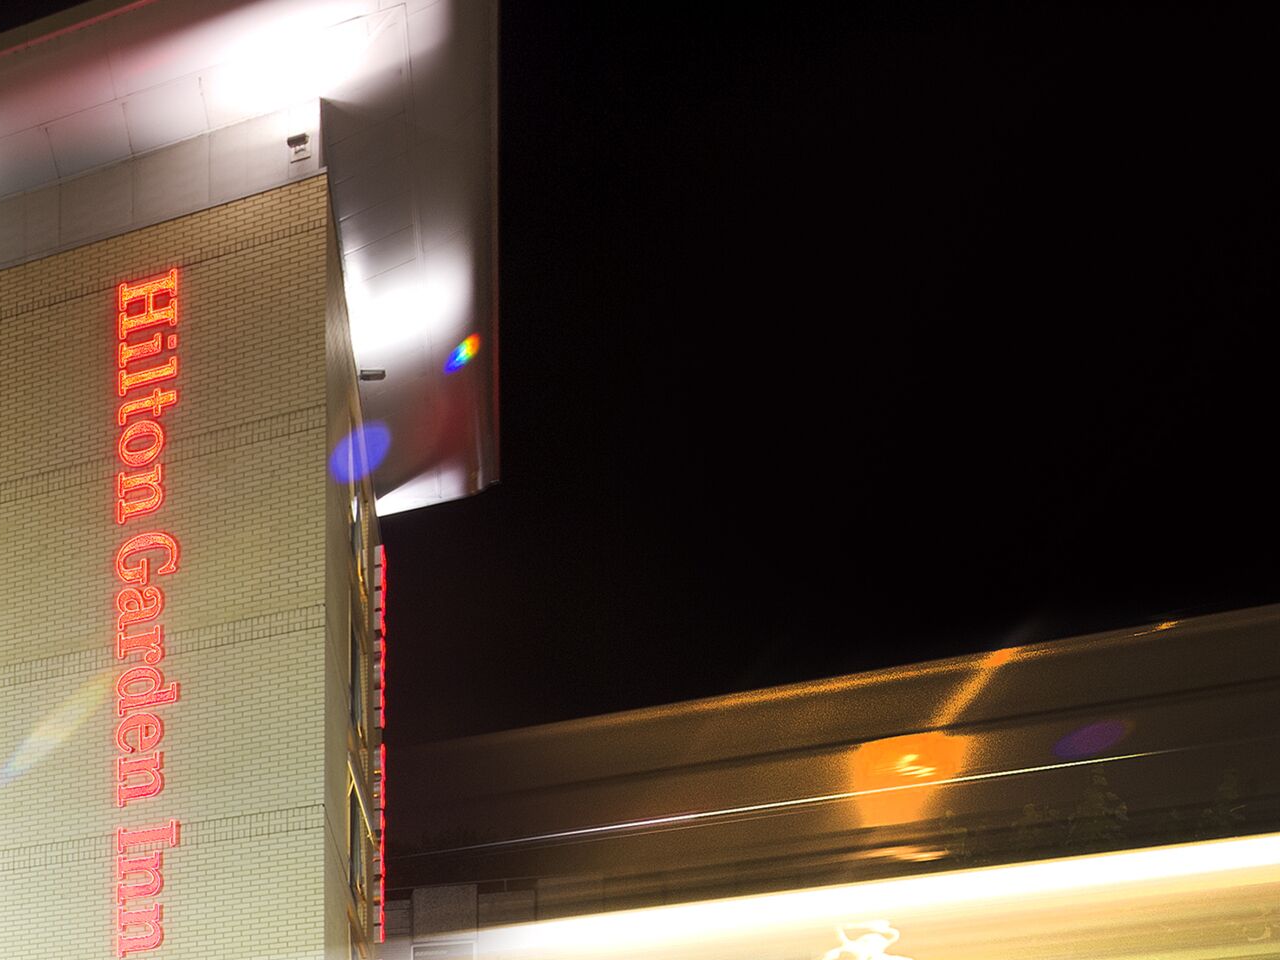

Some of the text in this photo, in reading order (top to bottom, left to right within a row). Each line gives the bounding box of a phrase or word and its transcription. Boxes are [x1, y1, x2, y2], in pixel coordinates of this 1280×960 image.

[115, 268, 179, 960] Hilton Garden Inn
